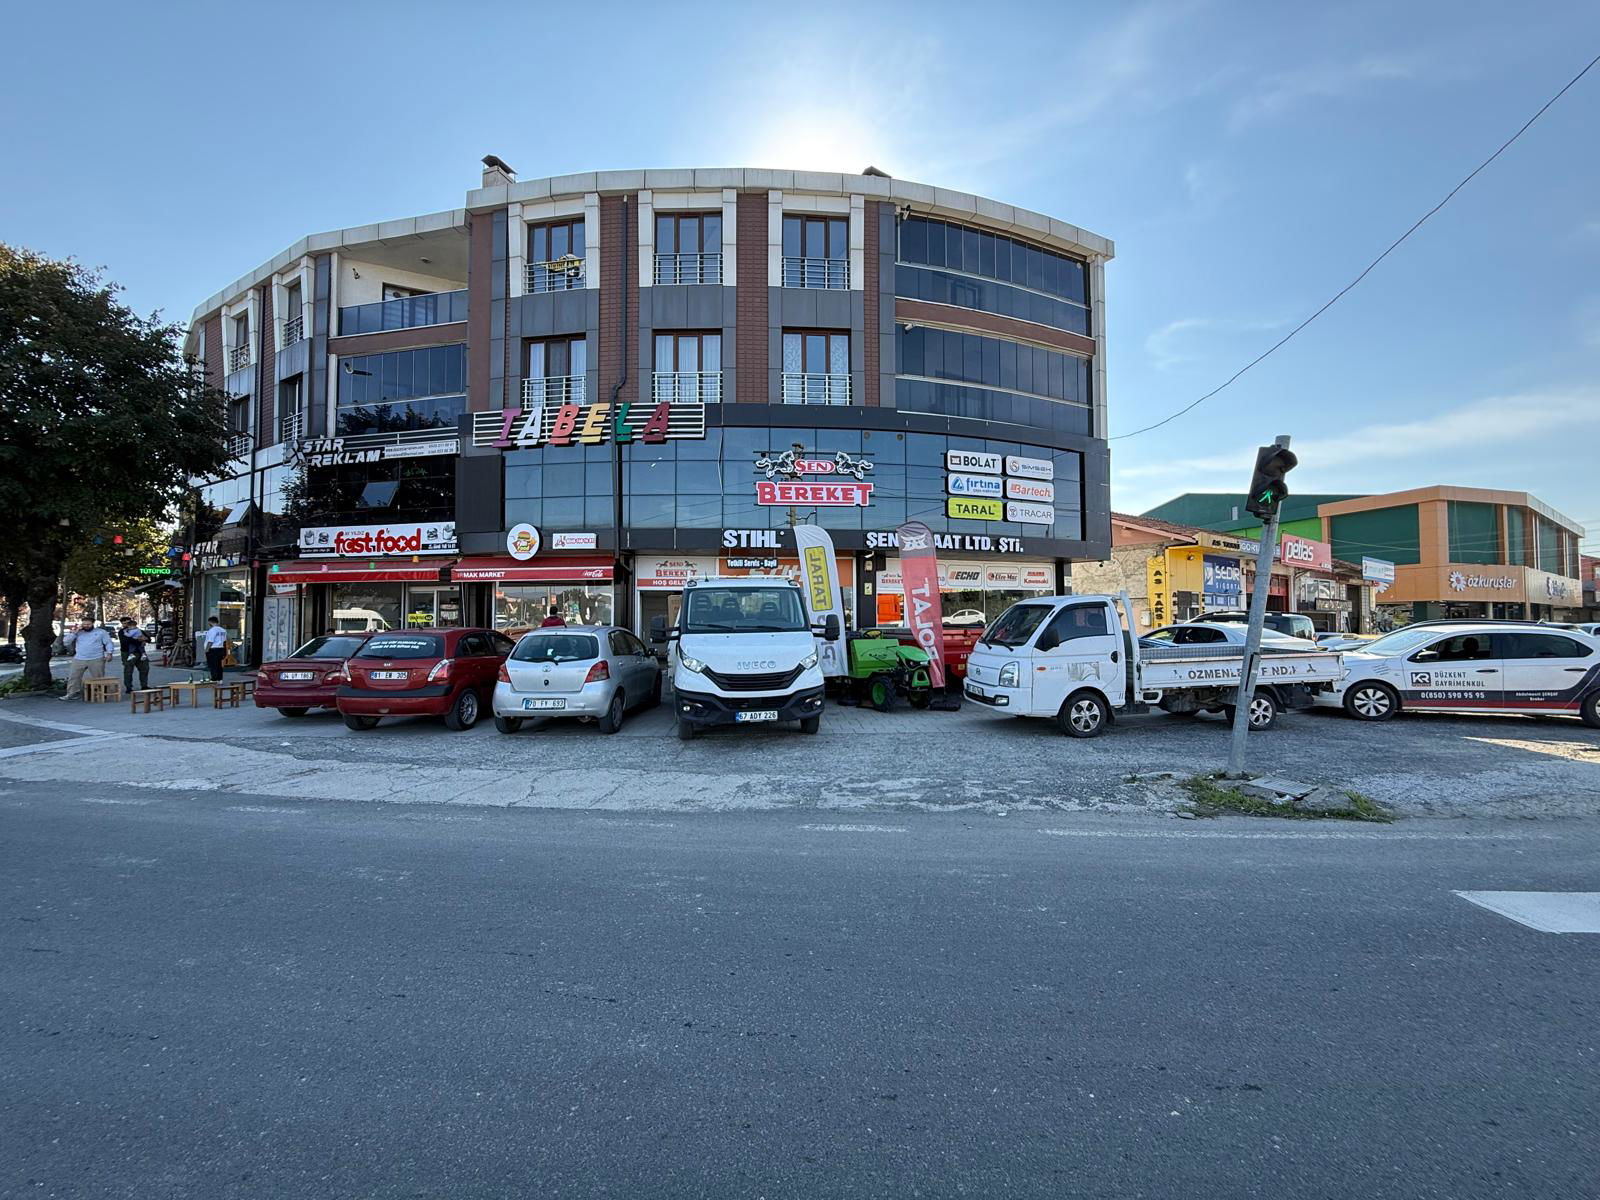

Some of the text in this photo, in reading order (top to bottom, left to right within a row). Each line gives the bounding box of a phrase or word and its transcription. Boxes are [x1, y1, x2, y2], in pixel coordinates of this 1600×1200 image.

[492, 401, 671, 447] TABELA
[303, 439, 344, 453] STAR
[311, 450, 381, 467] REKLAM
[963, 456, 997, 468] BOLAT
[757, 482, 873, 504] BEREKET
[956, 504, 995, 515] TARAL
[1020, 509, 1053, 518] TRACAR
[334, 528, 421, 554] fast food
[723, 530, 781, 548] STIHL
[866, 532, 900, 549] ŞEN
[965, 537, 995, 551] LTD.
[194, 540, 219, 555] STAR
[1286, 540, 1313, 561] petlas
[954, 572, 980, 580] ECHO
[737, 661, 777, 670] IVECO
[1447, 691, 1462, 699] 590
[764, 711, 776, 719] 226
